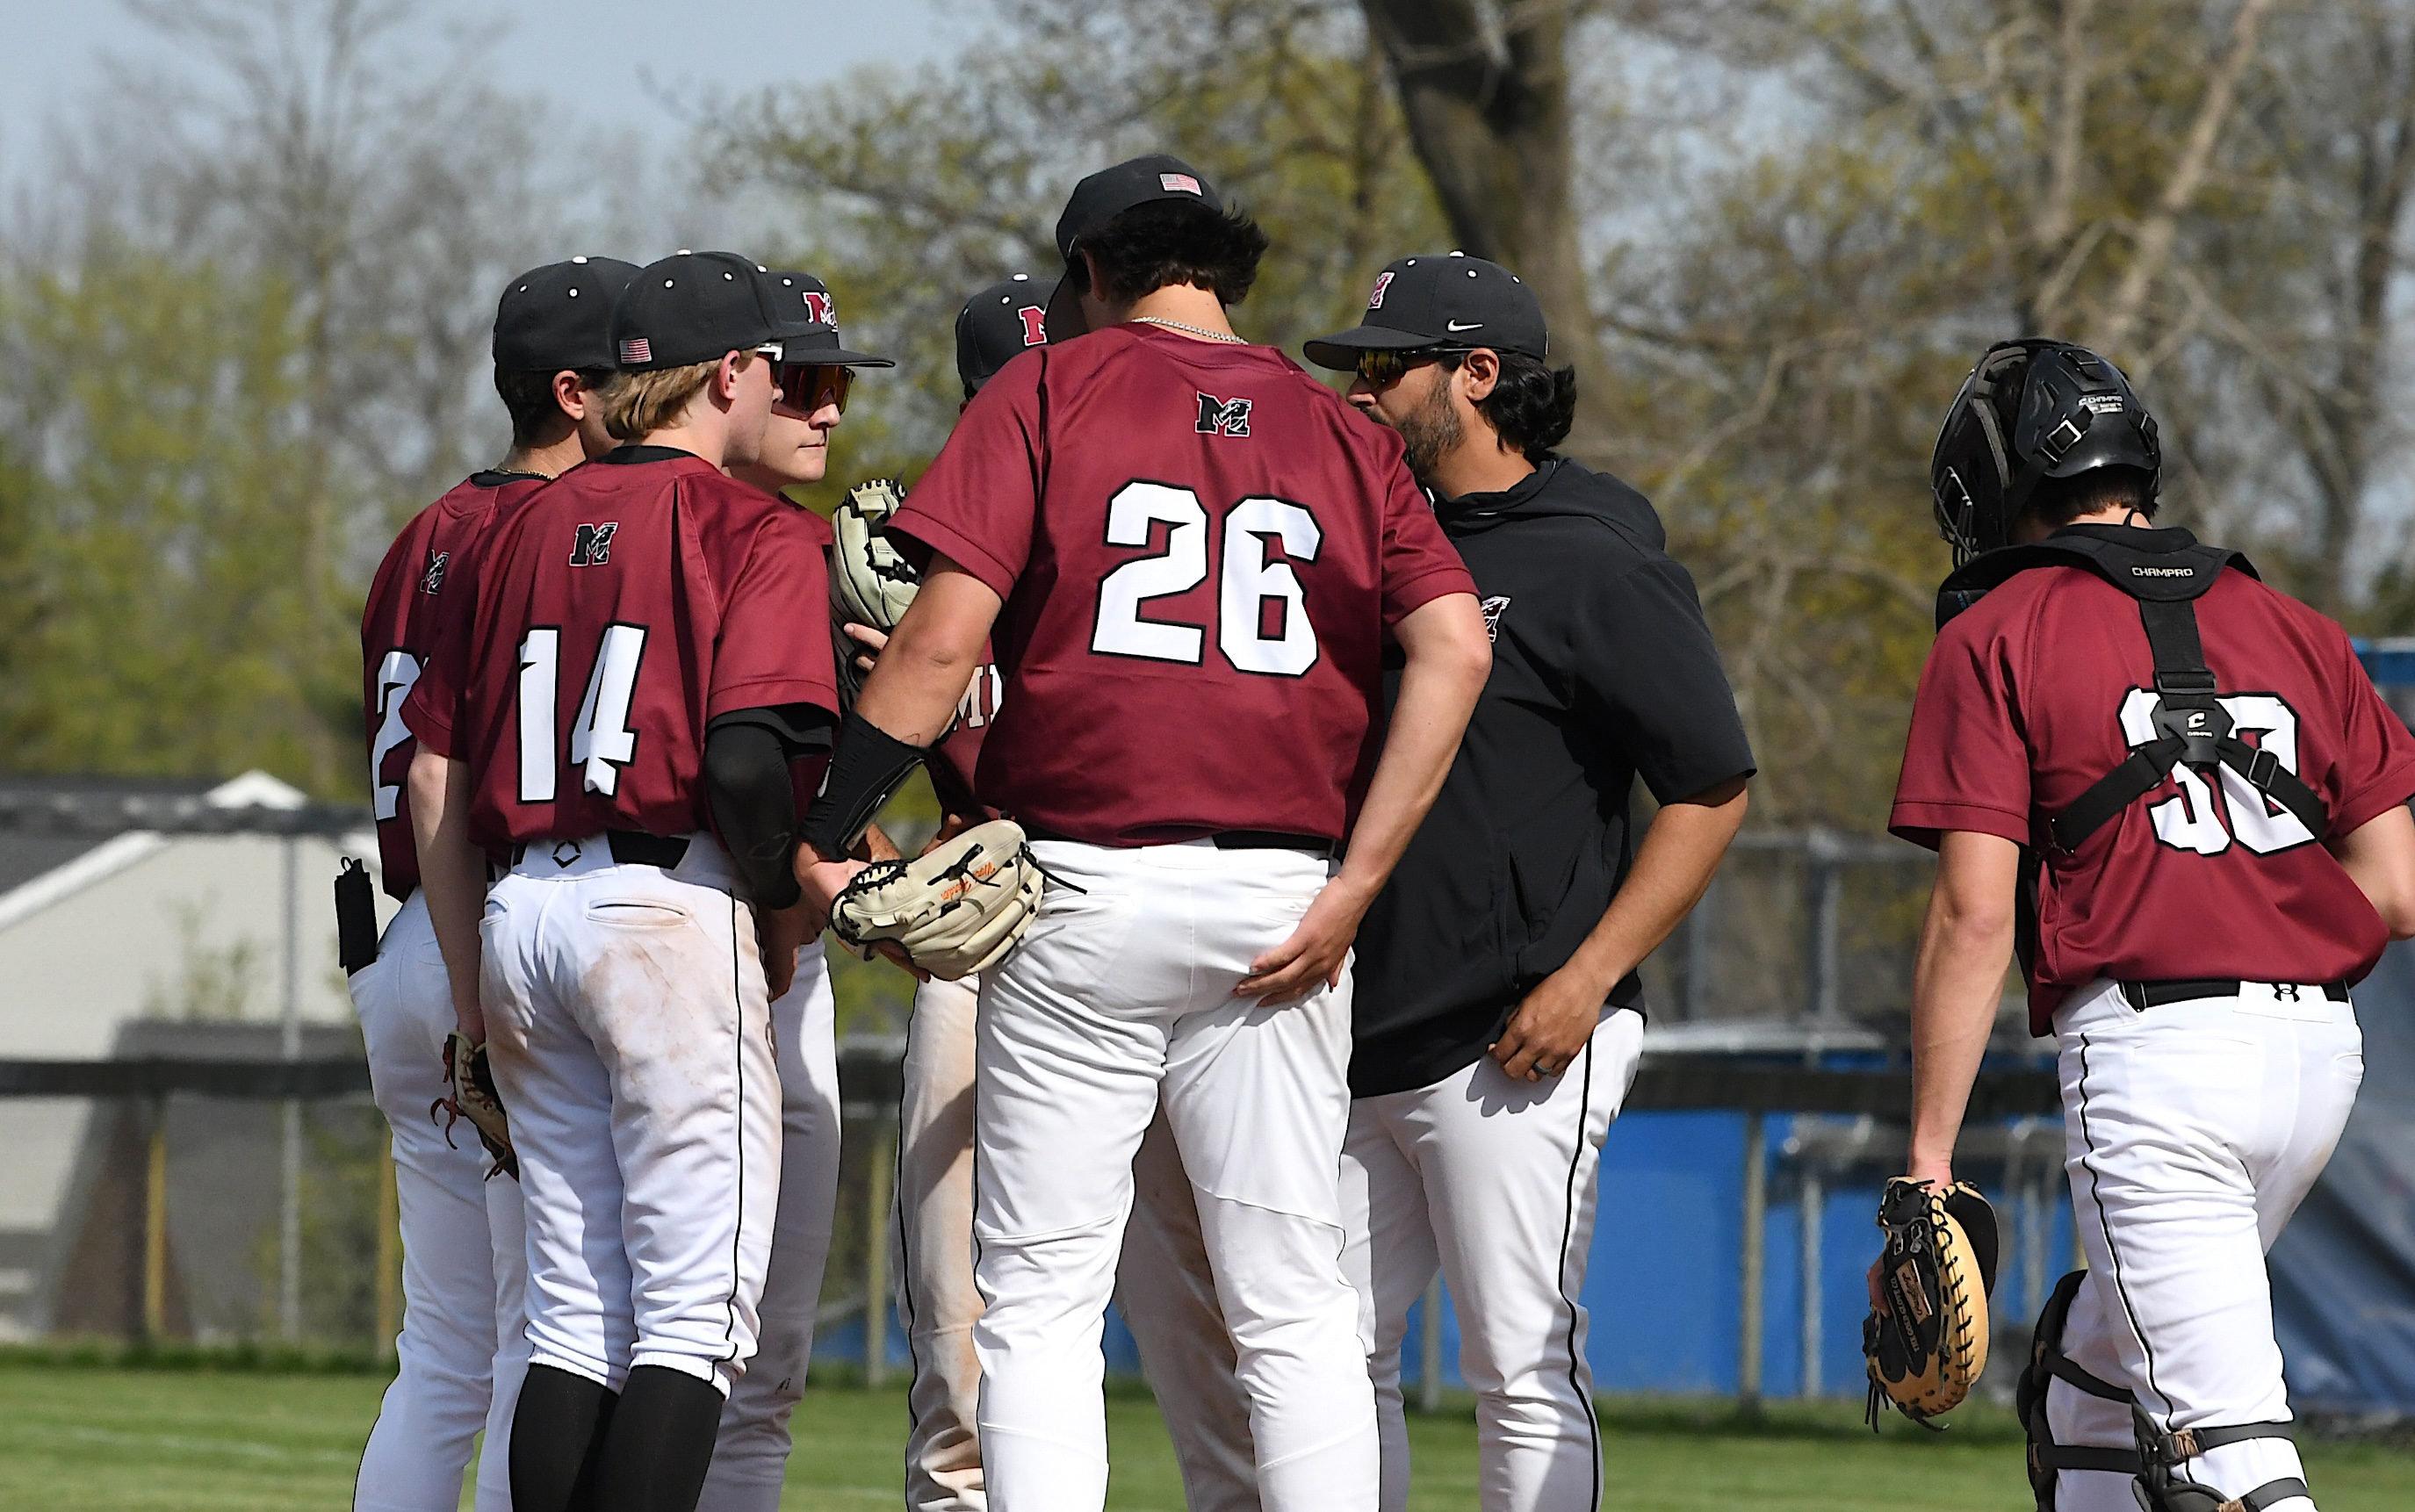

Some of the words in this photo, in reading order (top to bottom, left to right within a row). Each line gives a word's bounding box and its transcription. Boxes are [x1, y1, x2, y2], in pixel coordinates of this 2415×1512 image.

[1088, 478, 1324, 679] 26
[2131, 567, 2193, 577] CHAMPRO
[516, 622, 650, 804] 14
